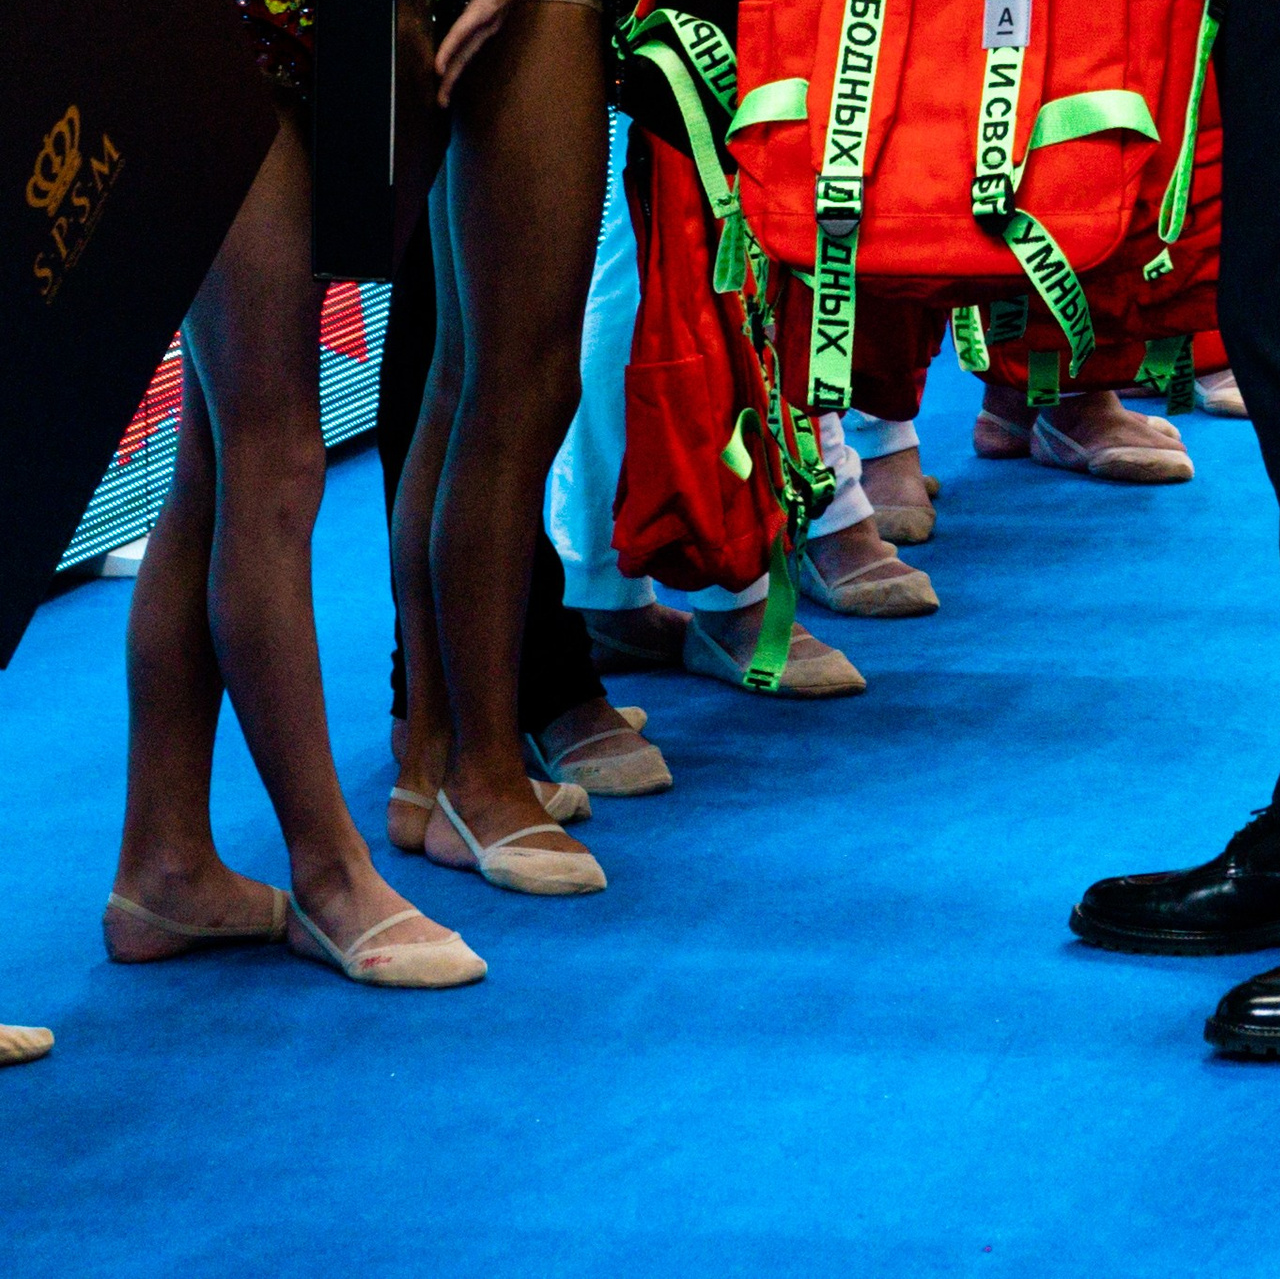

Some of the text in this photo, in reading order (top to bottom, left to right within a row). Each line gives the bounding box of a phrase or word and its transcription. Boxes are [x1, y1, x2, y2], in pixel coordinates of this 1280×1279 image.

[988, 63, 1018, 89] И
[815, 237, 853, 358] ДНЫХ
[1012, 221, 1090, 350] УМНЫХ
